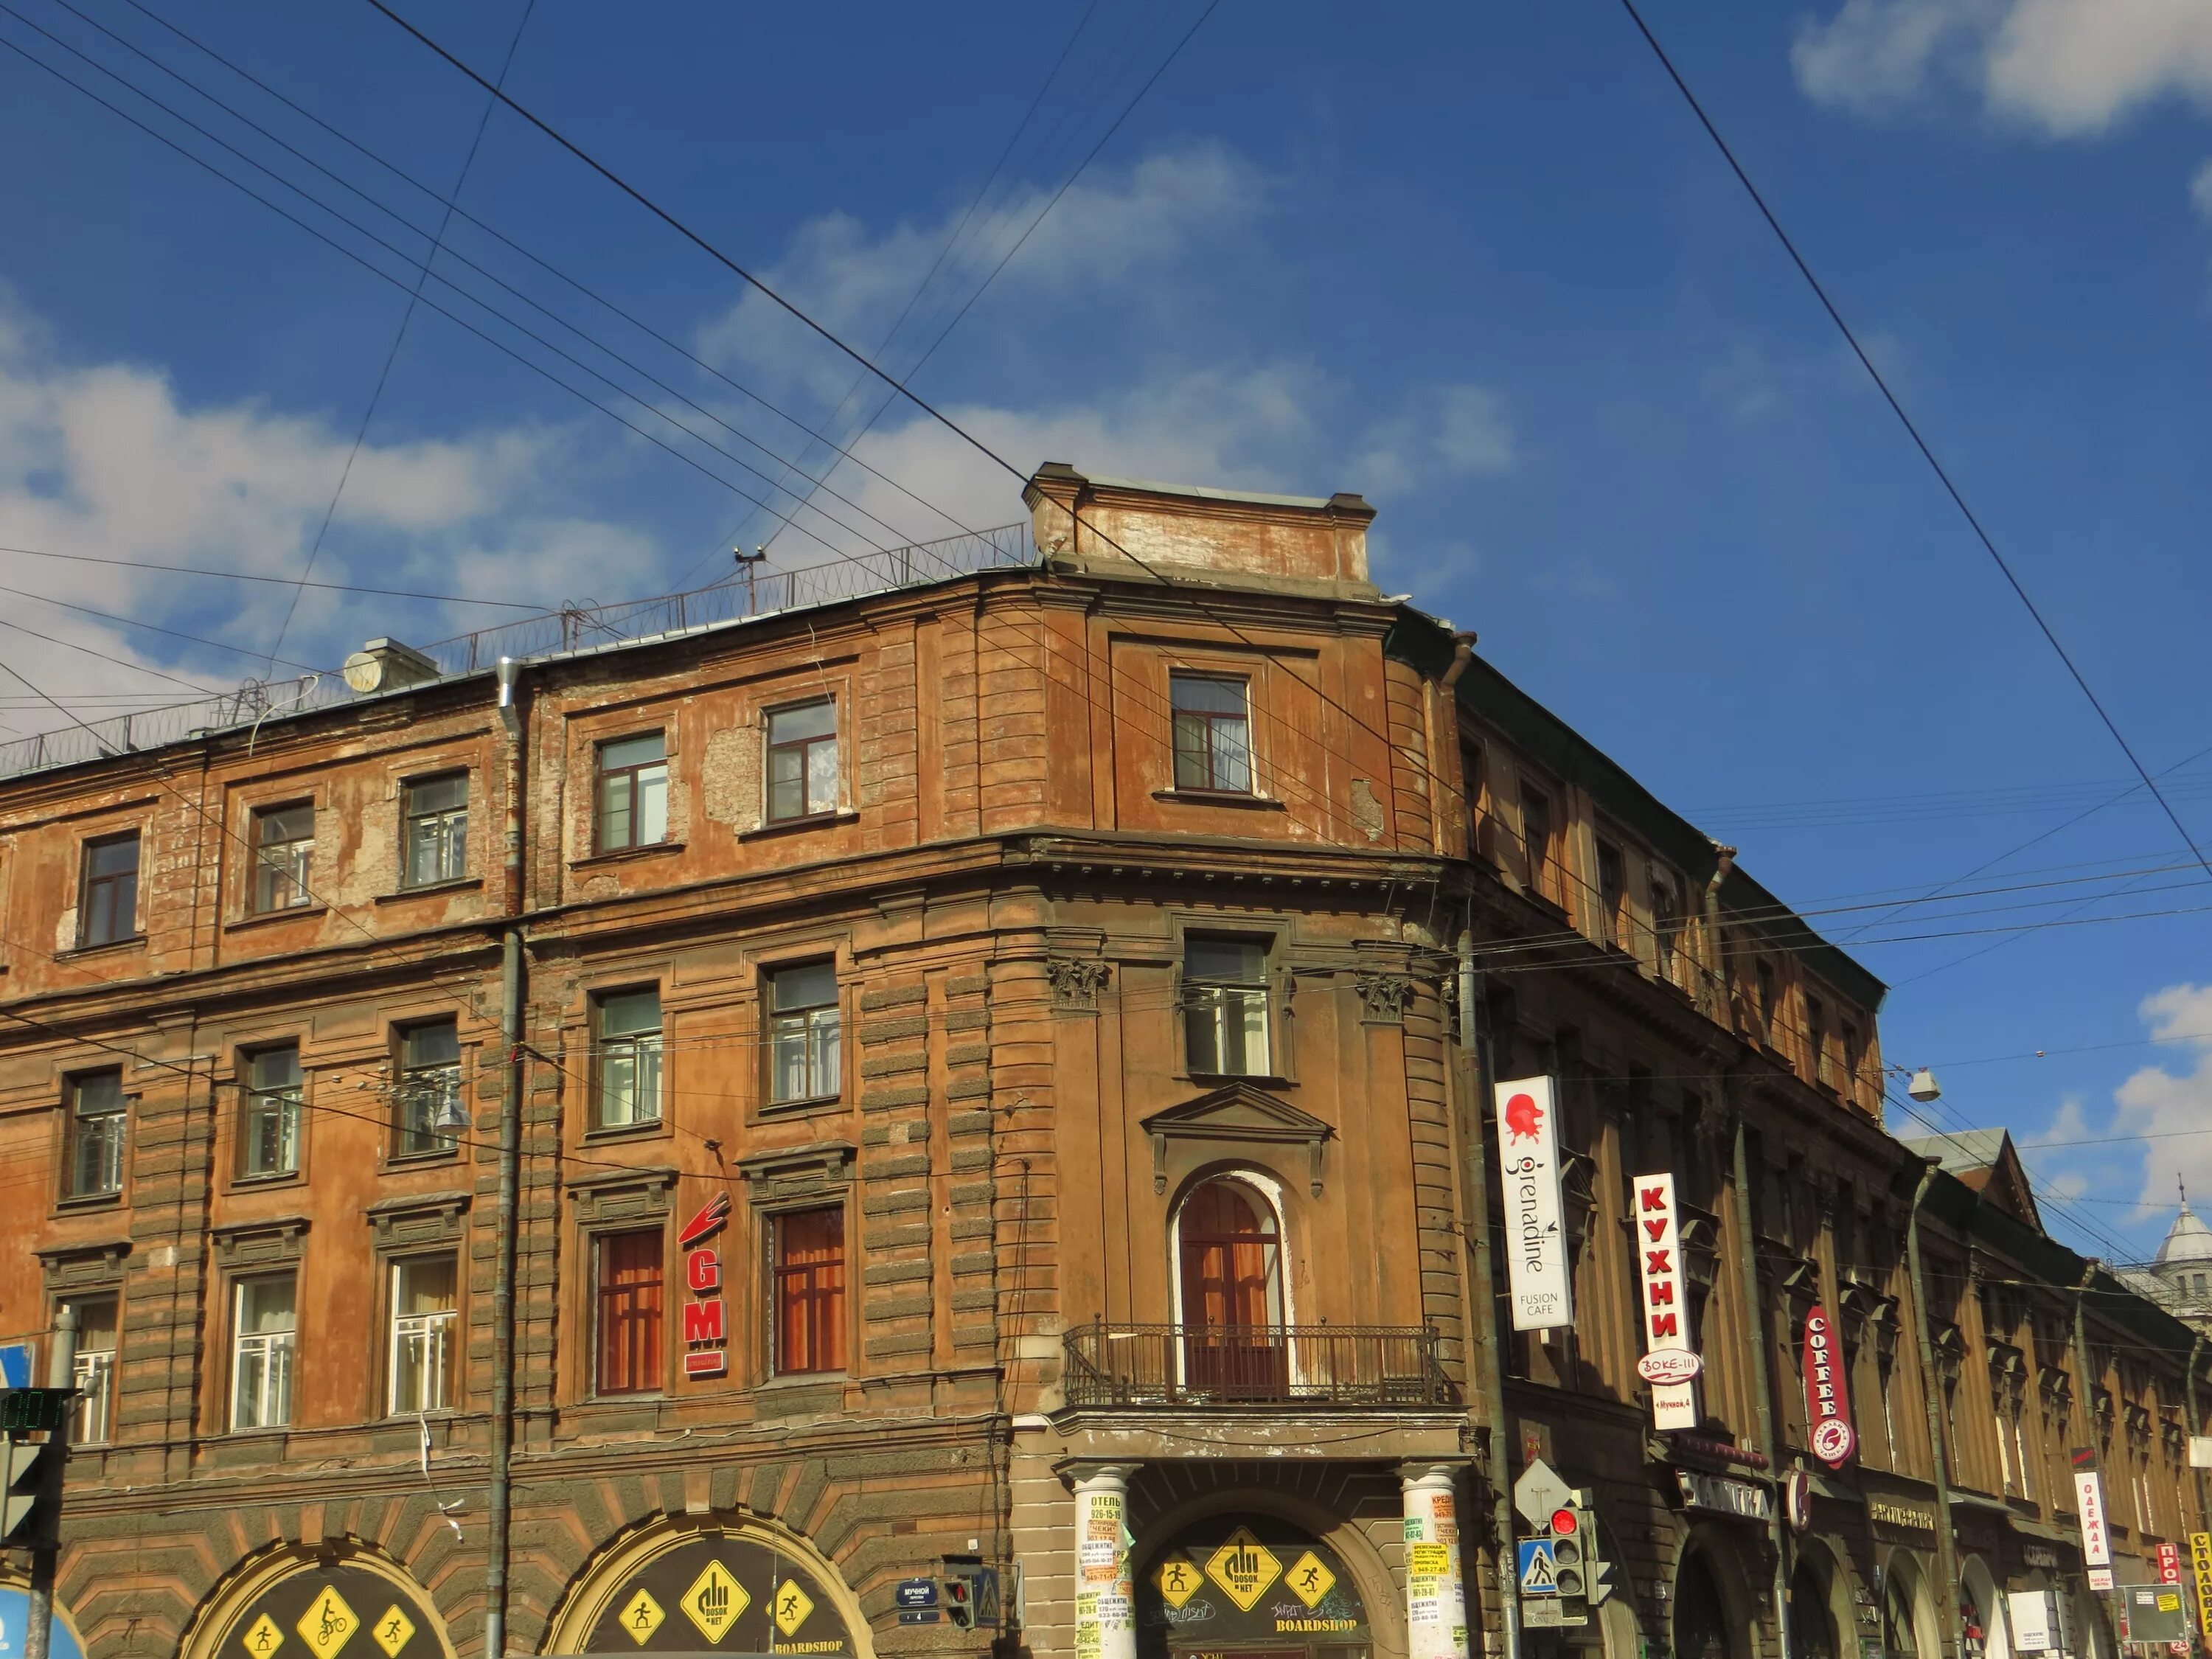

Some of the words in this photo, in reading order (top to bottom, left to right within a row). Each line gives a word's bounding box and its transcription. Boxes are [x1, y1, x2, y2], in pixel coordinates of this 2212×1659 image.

[1506, 1156, 1557, 1273] grenadine
[1641, 1187, 1677, 1338] КУХНИ
[1520, 1292, 1558, 1306] FUSION
[1527, 1304, 1554, 1316] CAFE
[1809, 1318, 1837, 1416] COFFEE
[1091, 1497, 1121, 1507] ОТЕЛЬ
[1091, 1509, 1121, 1519] 926-15-19
[2084, 1484, 2100, 1554] ОДЕЖДА
[1234, 1575, 1259, 1583] DOSOK
[905, 1586, 930, 1596] МУЧНОЙ
[706, 1607, 728, 1616] DOSOK
[917, 1613, 922, 1621] 4
[1276, 1619, 1357, 1632] BOARDSHOP
[775, 1640, 844, 1655] BOARDSHOP
[2174, 1641, 2188, 1649] 24
